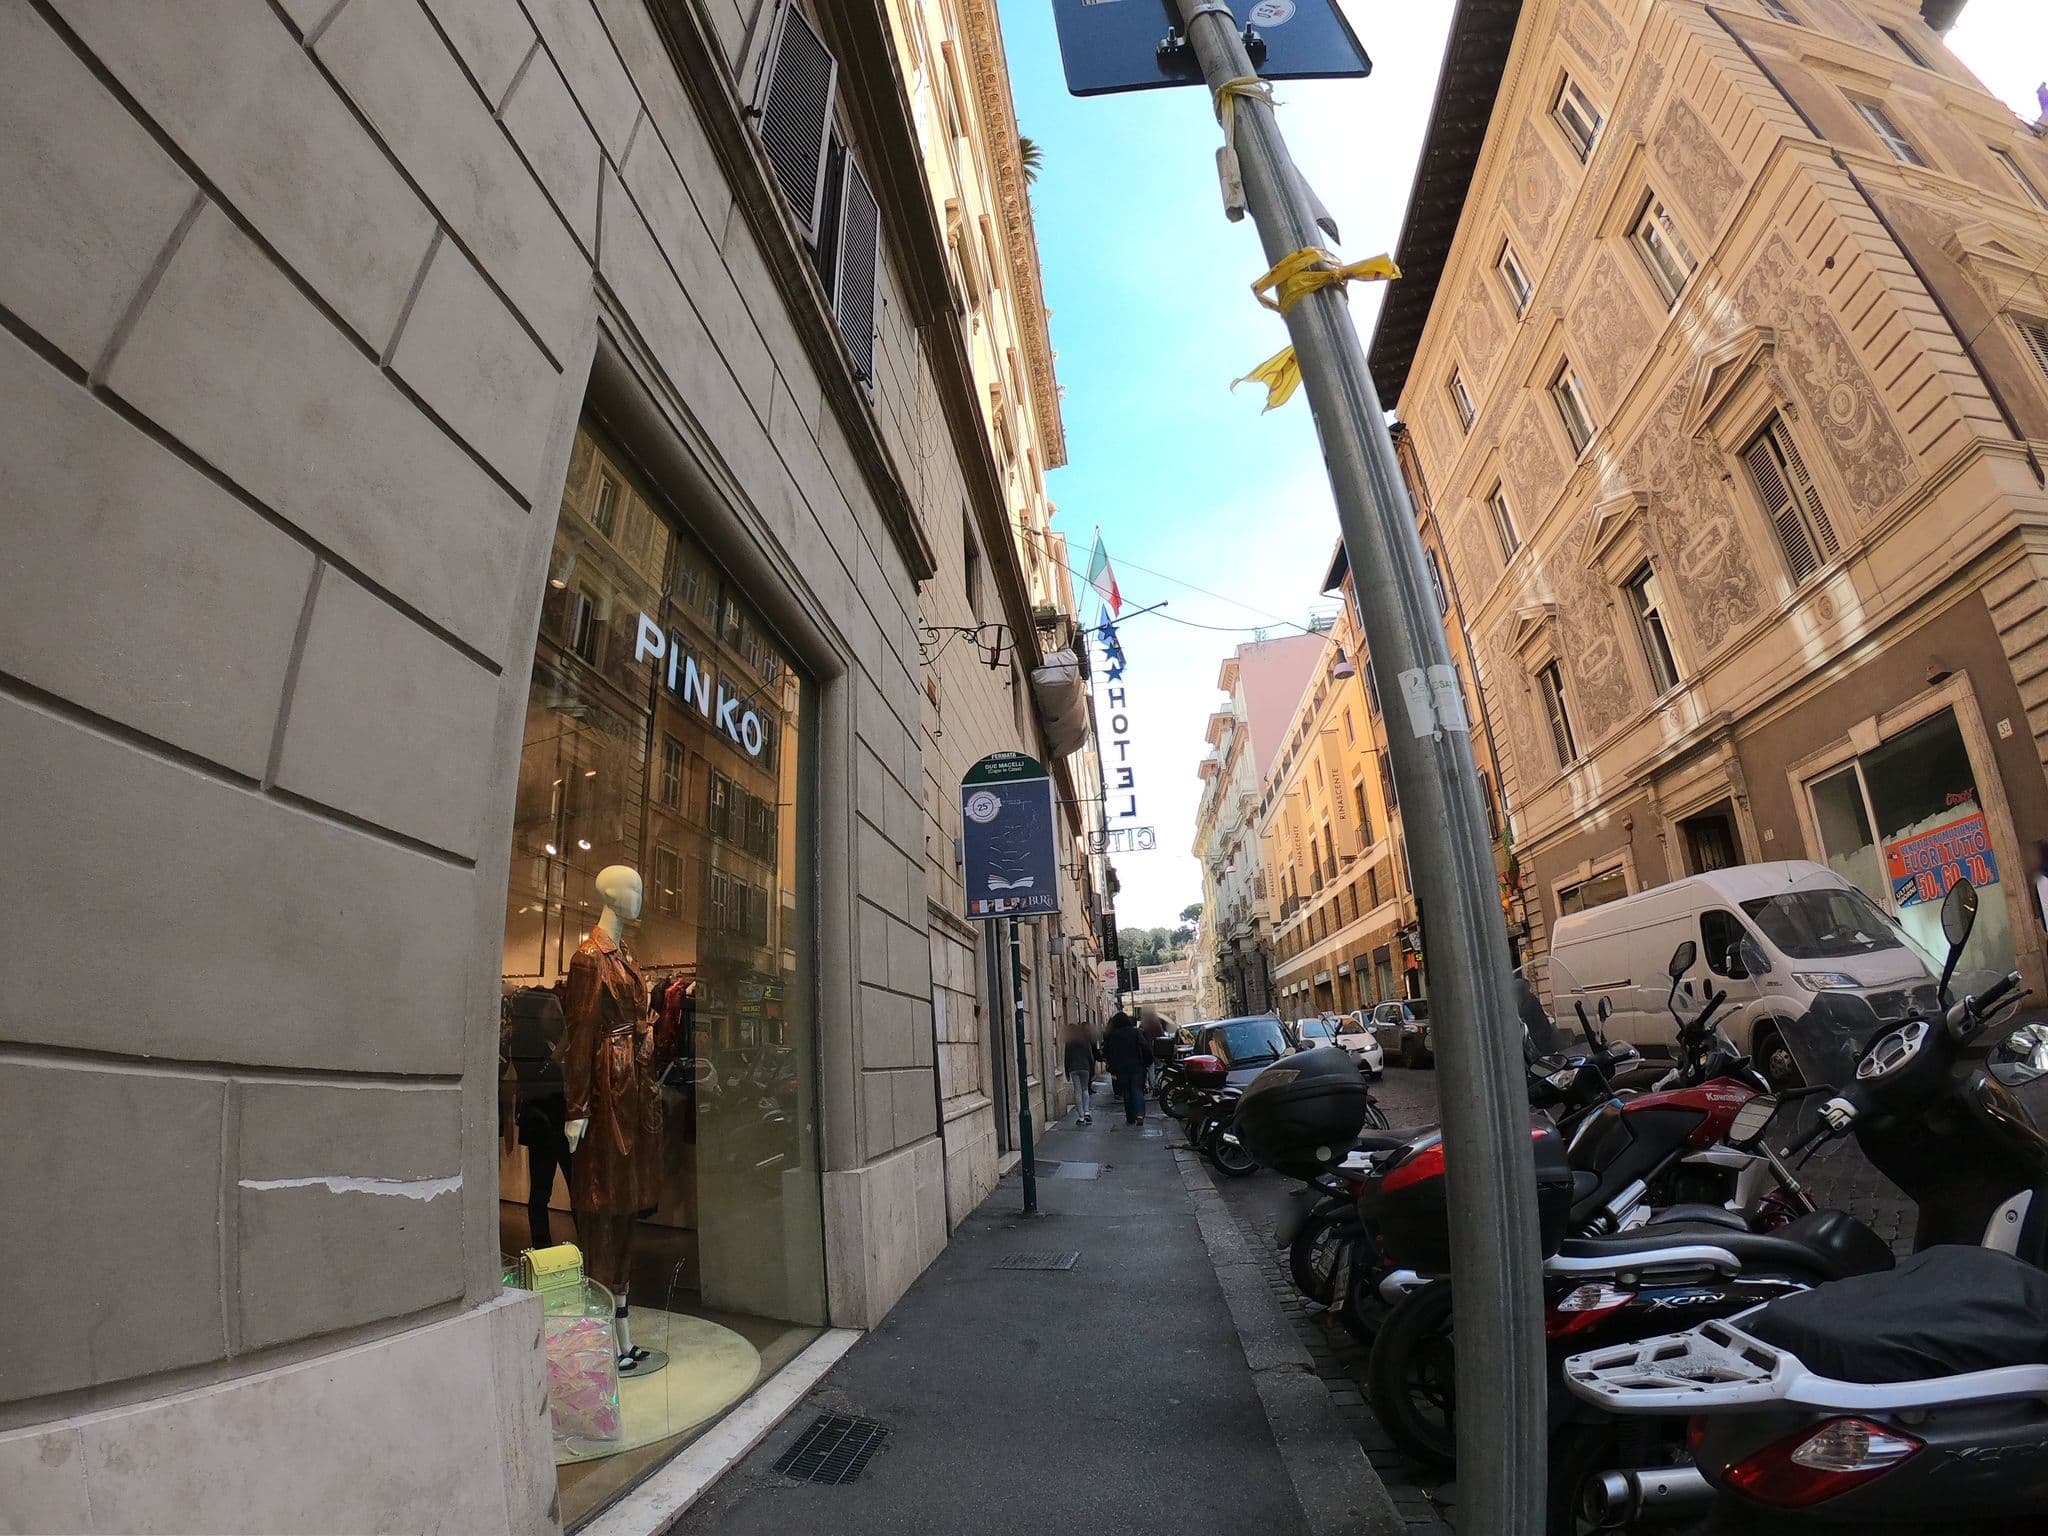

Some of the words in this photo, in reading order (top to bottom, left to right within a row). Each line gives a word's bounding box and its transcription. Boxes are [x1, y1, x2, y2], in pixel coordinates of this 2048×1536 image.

[1257, 3, 1280, 18] USA
[634, 611, 762, 756] PINKO
[991, 752, 1017, 760] FERMATA
[998, 760, 1025, 769] MACELLI
[1331, 767, 1347, 820] RINASCENTE
[1904, 843, 1943, 874] FUORI
[1943, 831, 1987, 861] TUTTO
